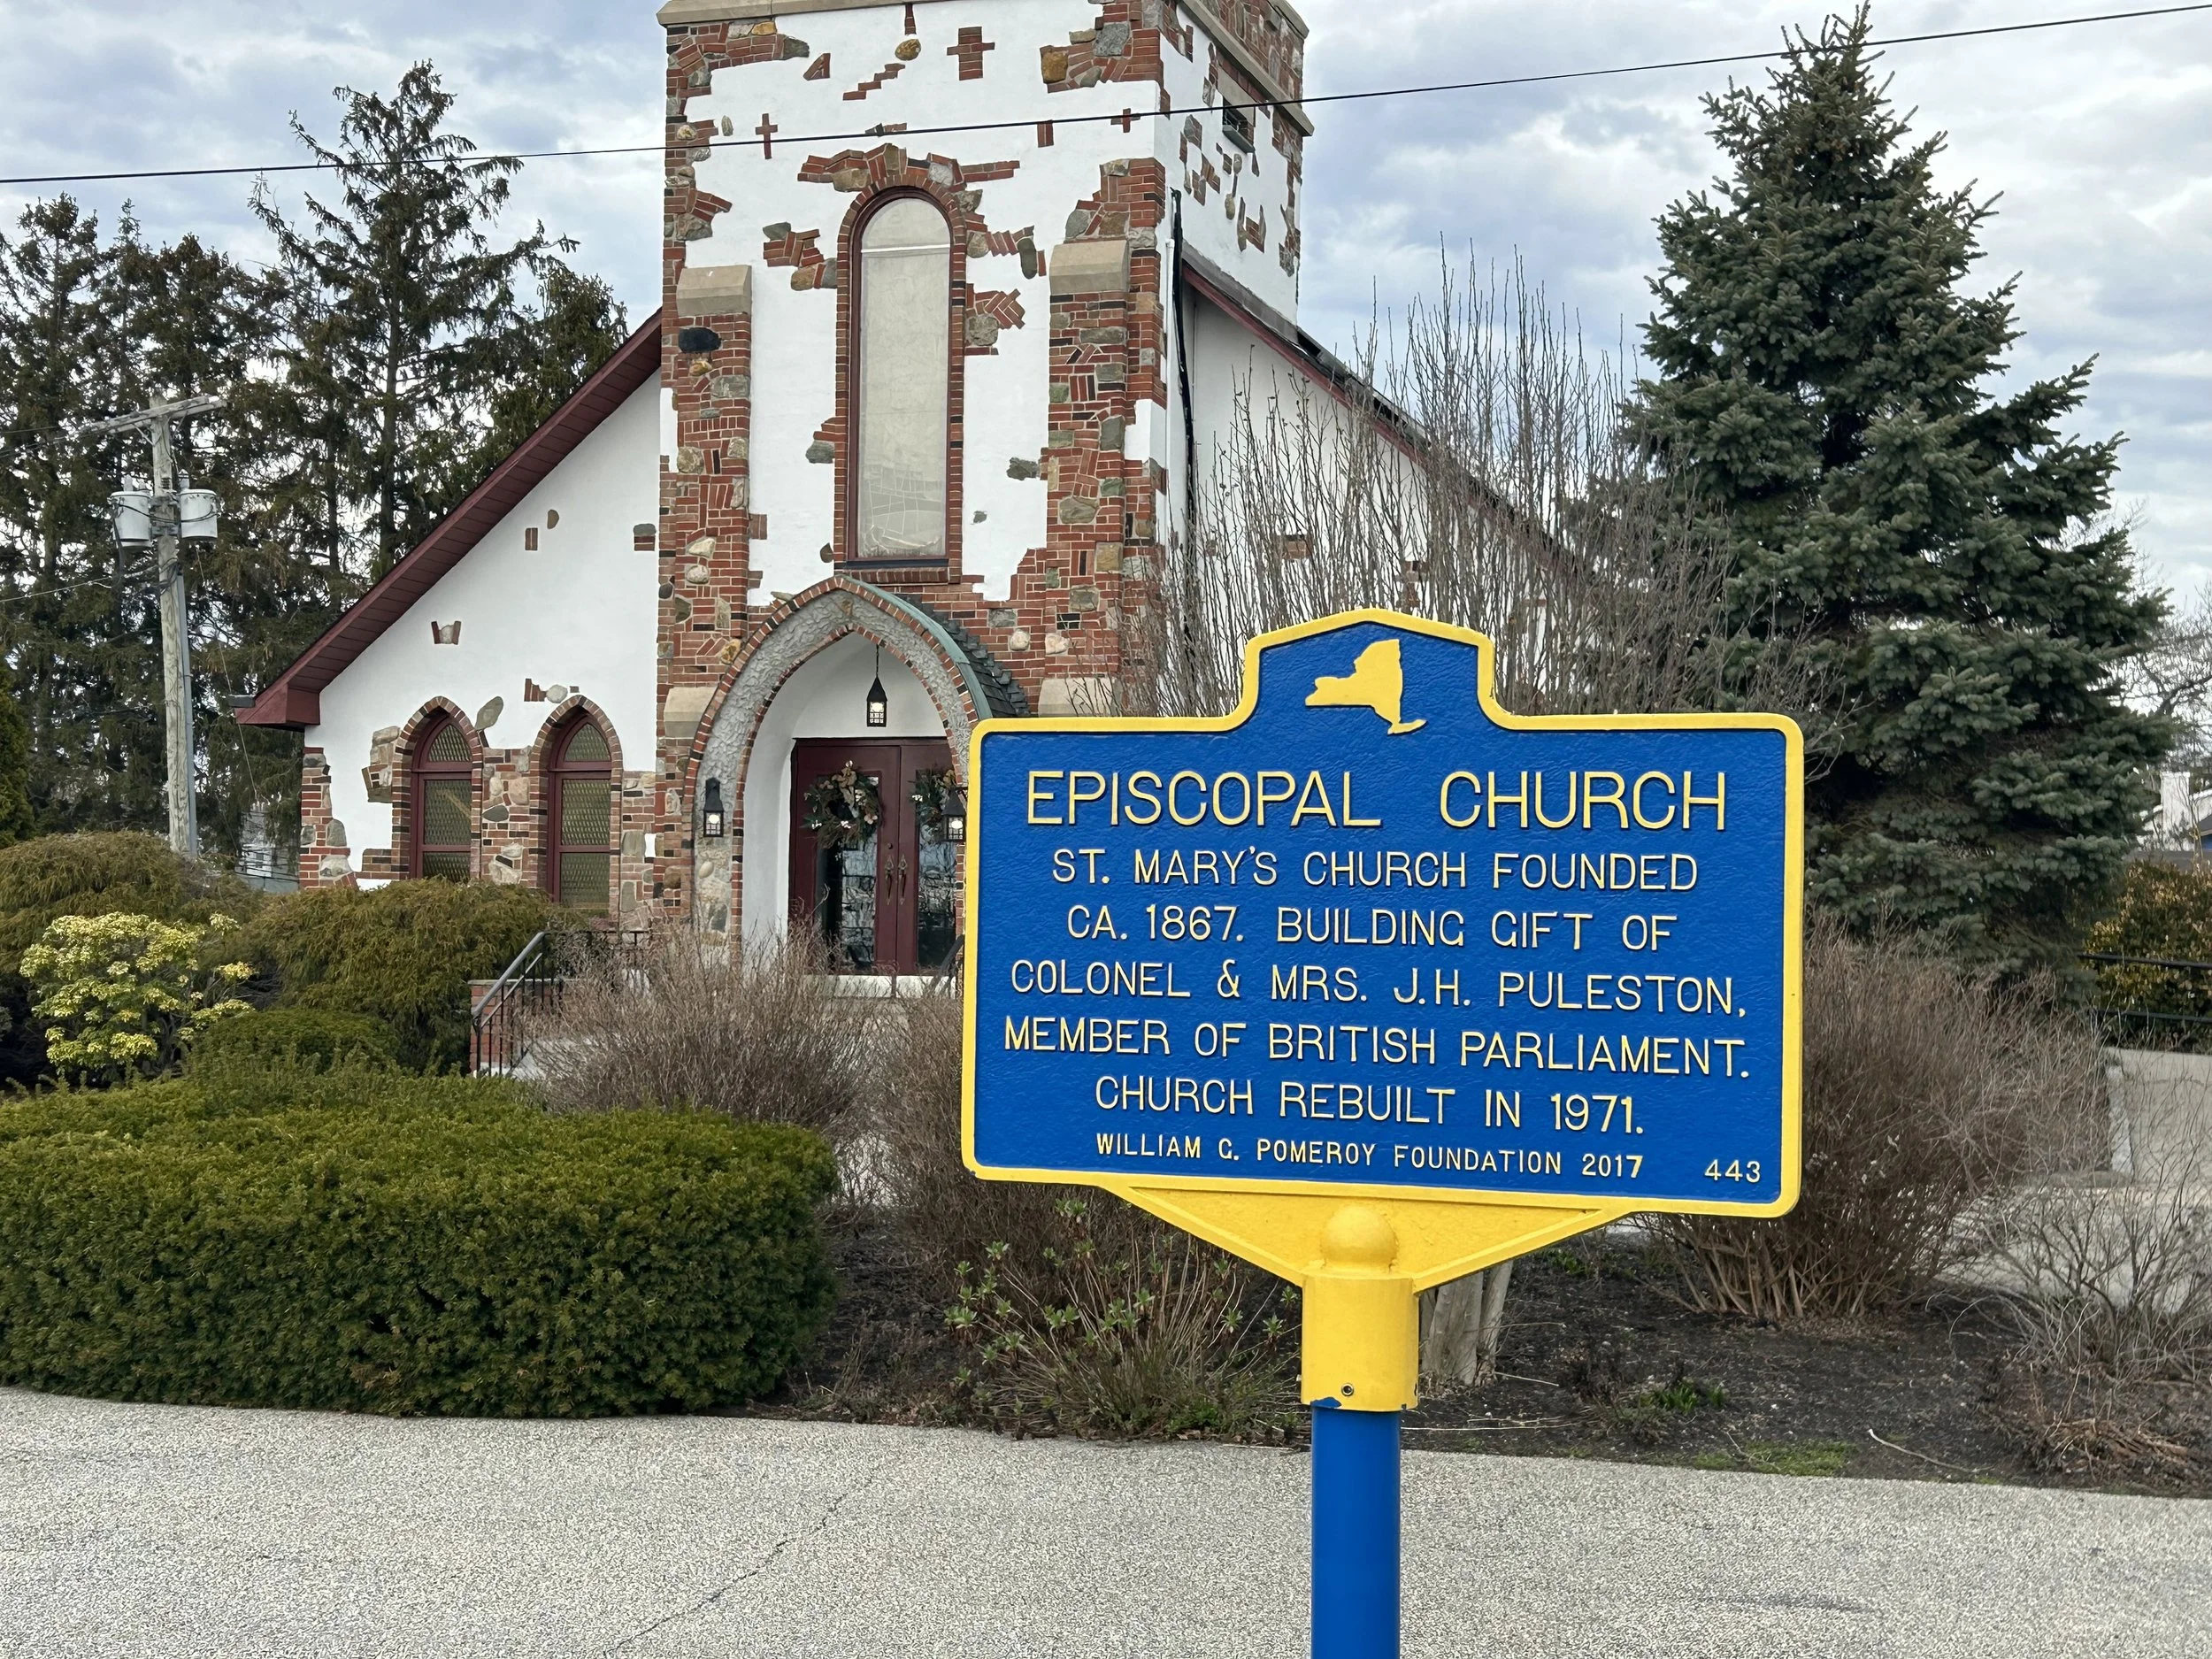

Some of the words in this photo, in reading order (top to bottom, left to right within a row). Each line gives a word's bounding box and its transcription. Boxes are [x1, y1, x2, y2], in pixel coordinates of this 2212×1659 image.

[1027, 770, 1381, 826] EPISCOPAL
[1440, 771, 1725, 831] CHURCH
[1052, 848, 1110, 884] ST.
[1134, 845, 1277, 886] MARY'S
[1303, 850, 1466, 887] CHURCH
[1493, 852, 1698, 890] FOUNDED
[1067, 904, 1126, 940] CA.
[1146, 903, 1244, 941] 1867.
[1277, 906, 1464, 947] BUILDING
[1491, 910, 1594, 950] GIFT
[1622, 914, 1678, 951] OF
[1011, 959, 1191, 997] COLONEL
[1217, 958, 1240, 998] &
[1271, 964, 1367, 1002] MRS.
[1394, 967, 1471, 1006] J.H.
[1004, 1015, 1171, 1055] MEMBER
[1194, 1022, 1247, 1057] OF
[1269, 1023, 1435, 1064] BRITISH
[1460, 1031, 1748, 1077] PARLIAMENT.
[1095, 1075, 1254, 1115] CHURCH
[1279, 1081, 1455, 1125] REBUILT
[1486, 1088, 1520, 1128] IN
[1550, 1093, 1645, 1134] 1971.
[1096, 1133, 1201, 1159] WILLIAM
[1218, 1137, 1240, 1160] G.
[1256, 1138, 1376, 1166] POMEROY
[1394, 1144, 1561, 1175] FOUNDATION
[1581, 1153, 1643, 1179] 2017
[1704, 1159, 1761, 1183] 443
